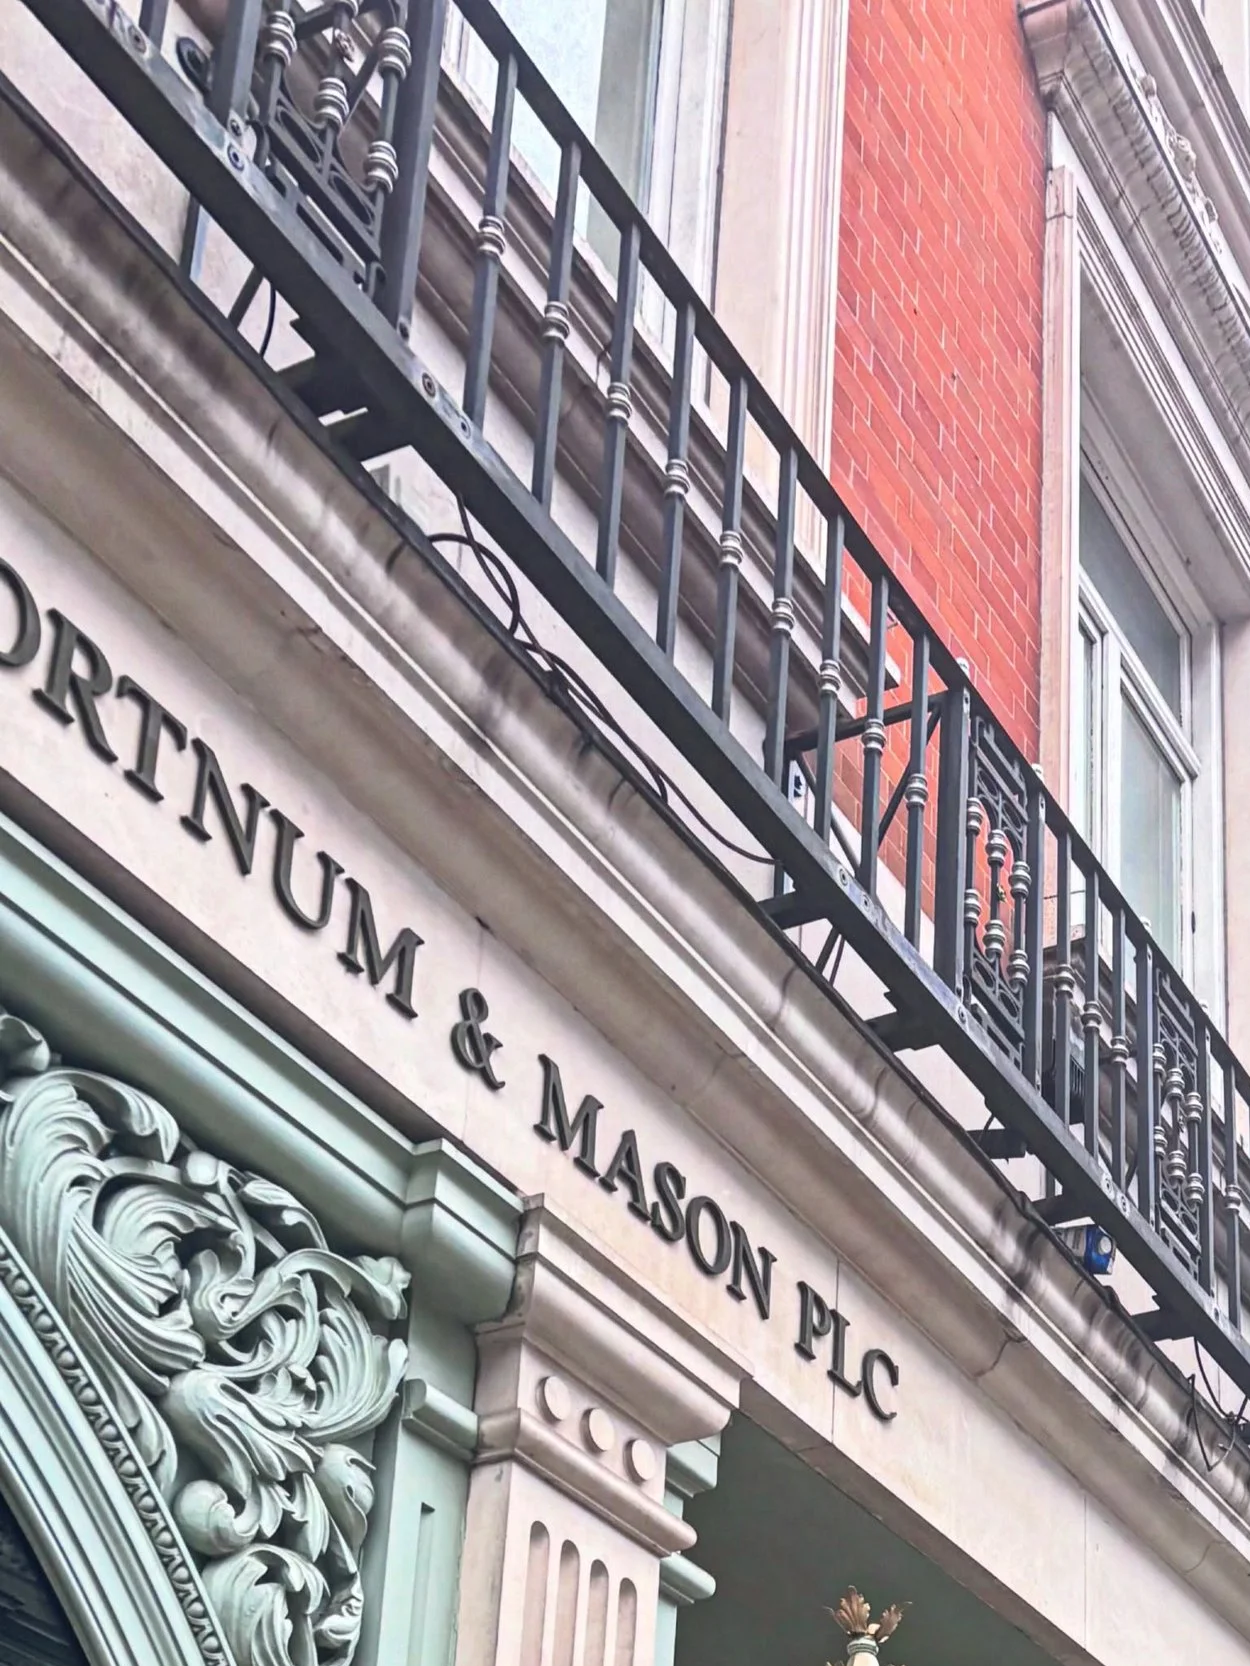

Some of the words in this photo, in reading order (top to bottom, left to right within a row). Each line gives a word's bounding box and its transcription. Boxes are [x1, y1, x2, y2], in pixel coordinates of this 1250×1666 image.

[450, 987, 506, 1092] &
[534, 1053, 779, 1321] MASON
[794, 1279, 900, 1424] PLC
